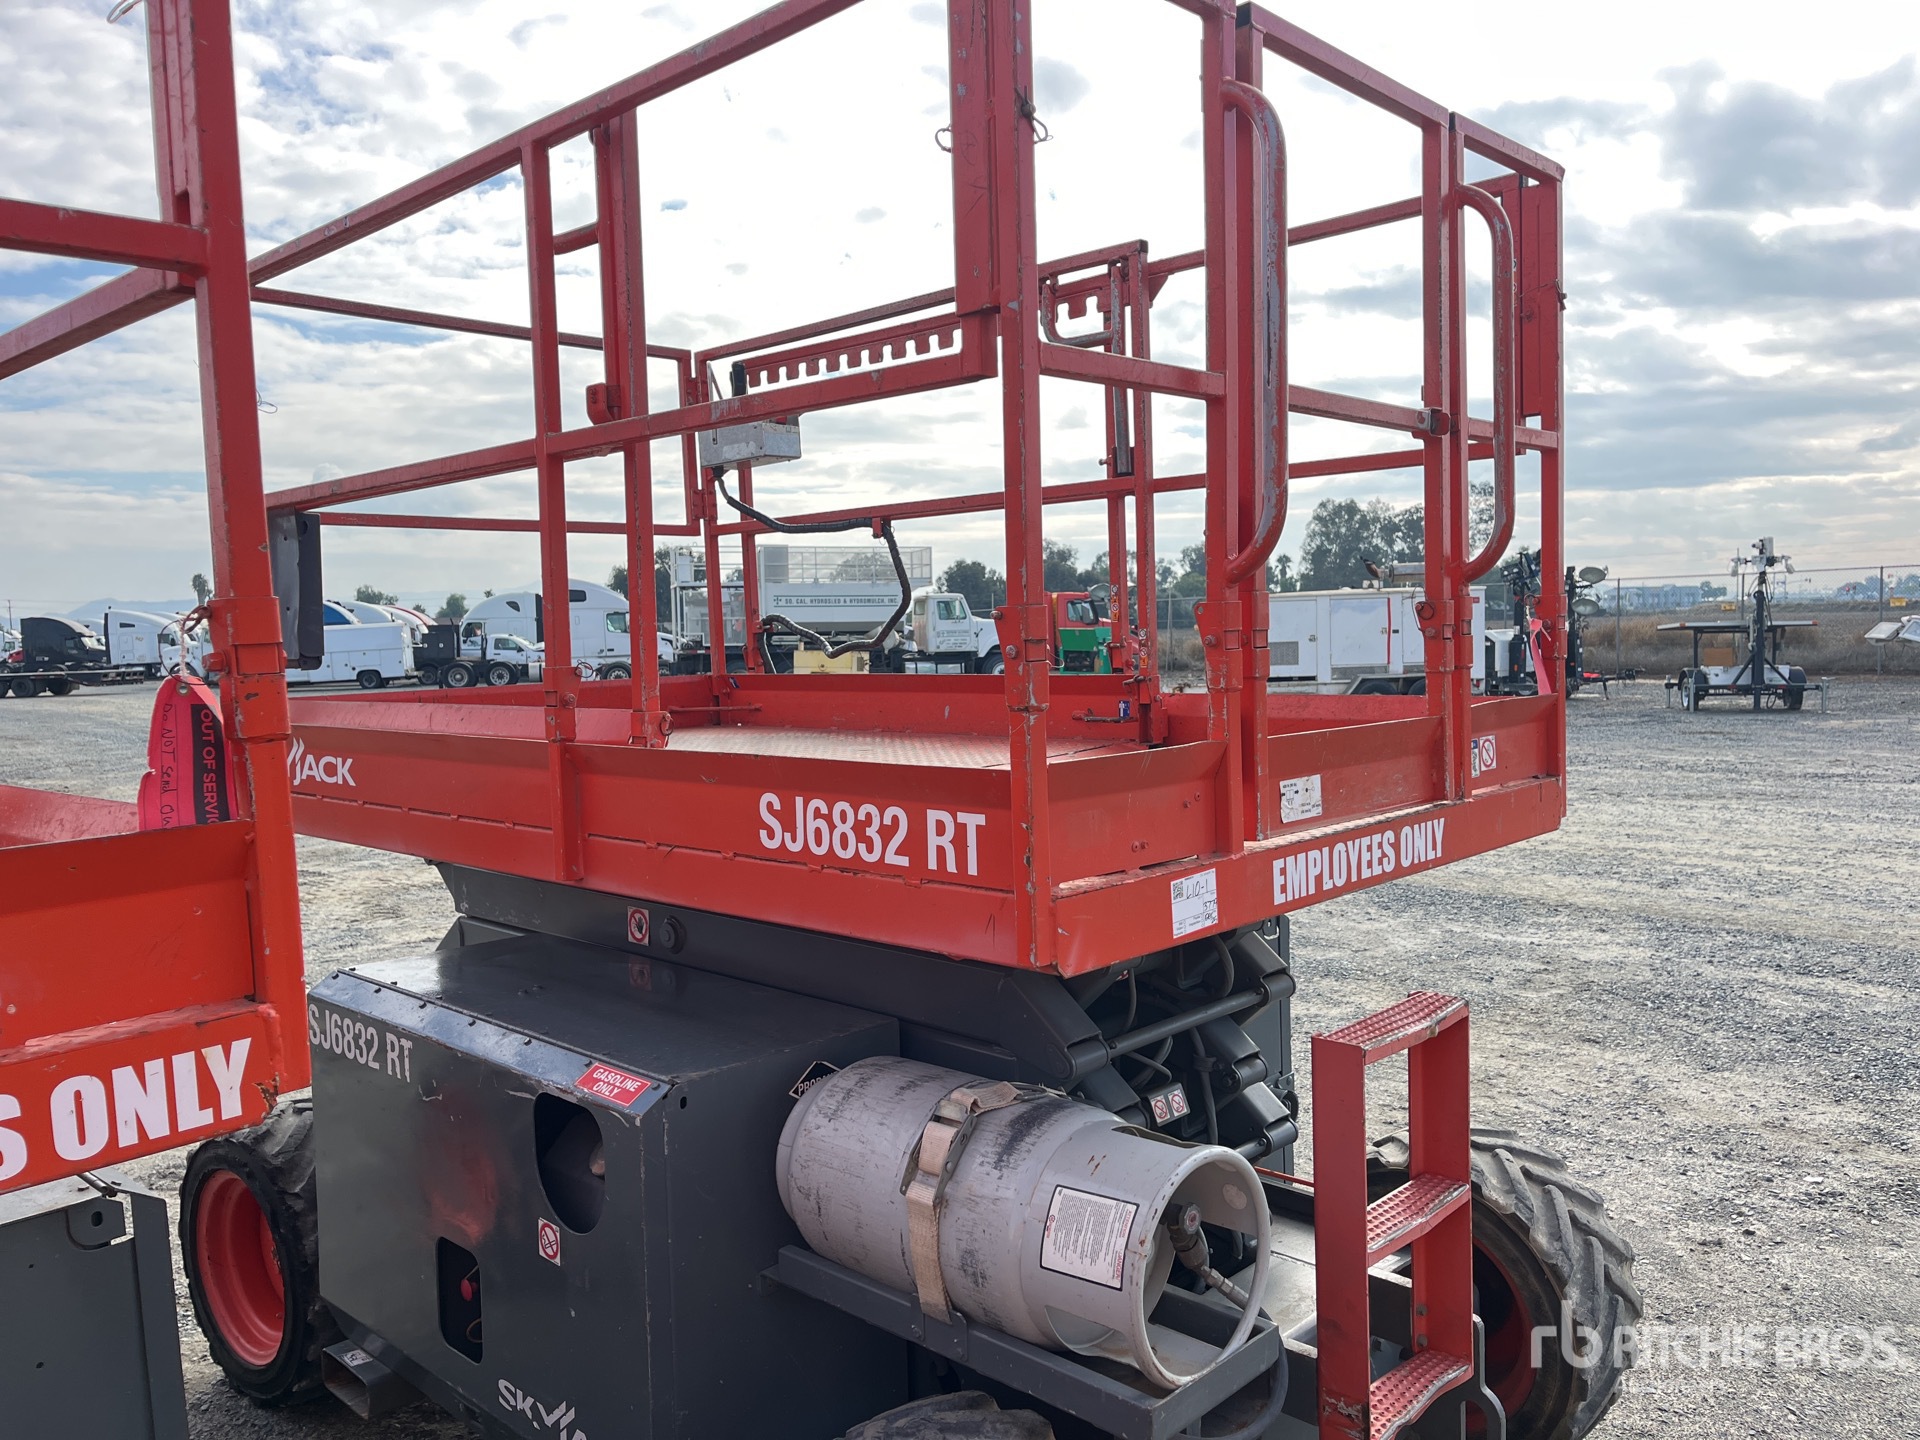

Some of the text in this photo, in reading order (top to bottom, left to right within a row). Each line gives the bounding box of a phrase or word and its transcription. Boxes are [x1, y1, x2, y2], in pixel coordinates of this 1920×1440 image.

[161, 728, 175, 762] NOT
[201, 709, 215, 743] OUT
[203, 747, 216, 769] OF
[287, 737, 356, 787] JACK
[759, 792, 986, 876] SJ6832 RT
[1273, 818, 1445, 905] EMPLOYEES ONLY
[309, 1003, 413, 1083] SJ6832 RT
[51, 1038, 251, 1161] ONLY
[592, 1069, 641, 1092] GASOLINE
[592, 1081, 621, 1097] ONLY
